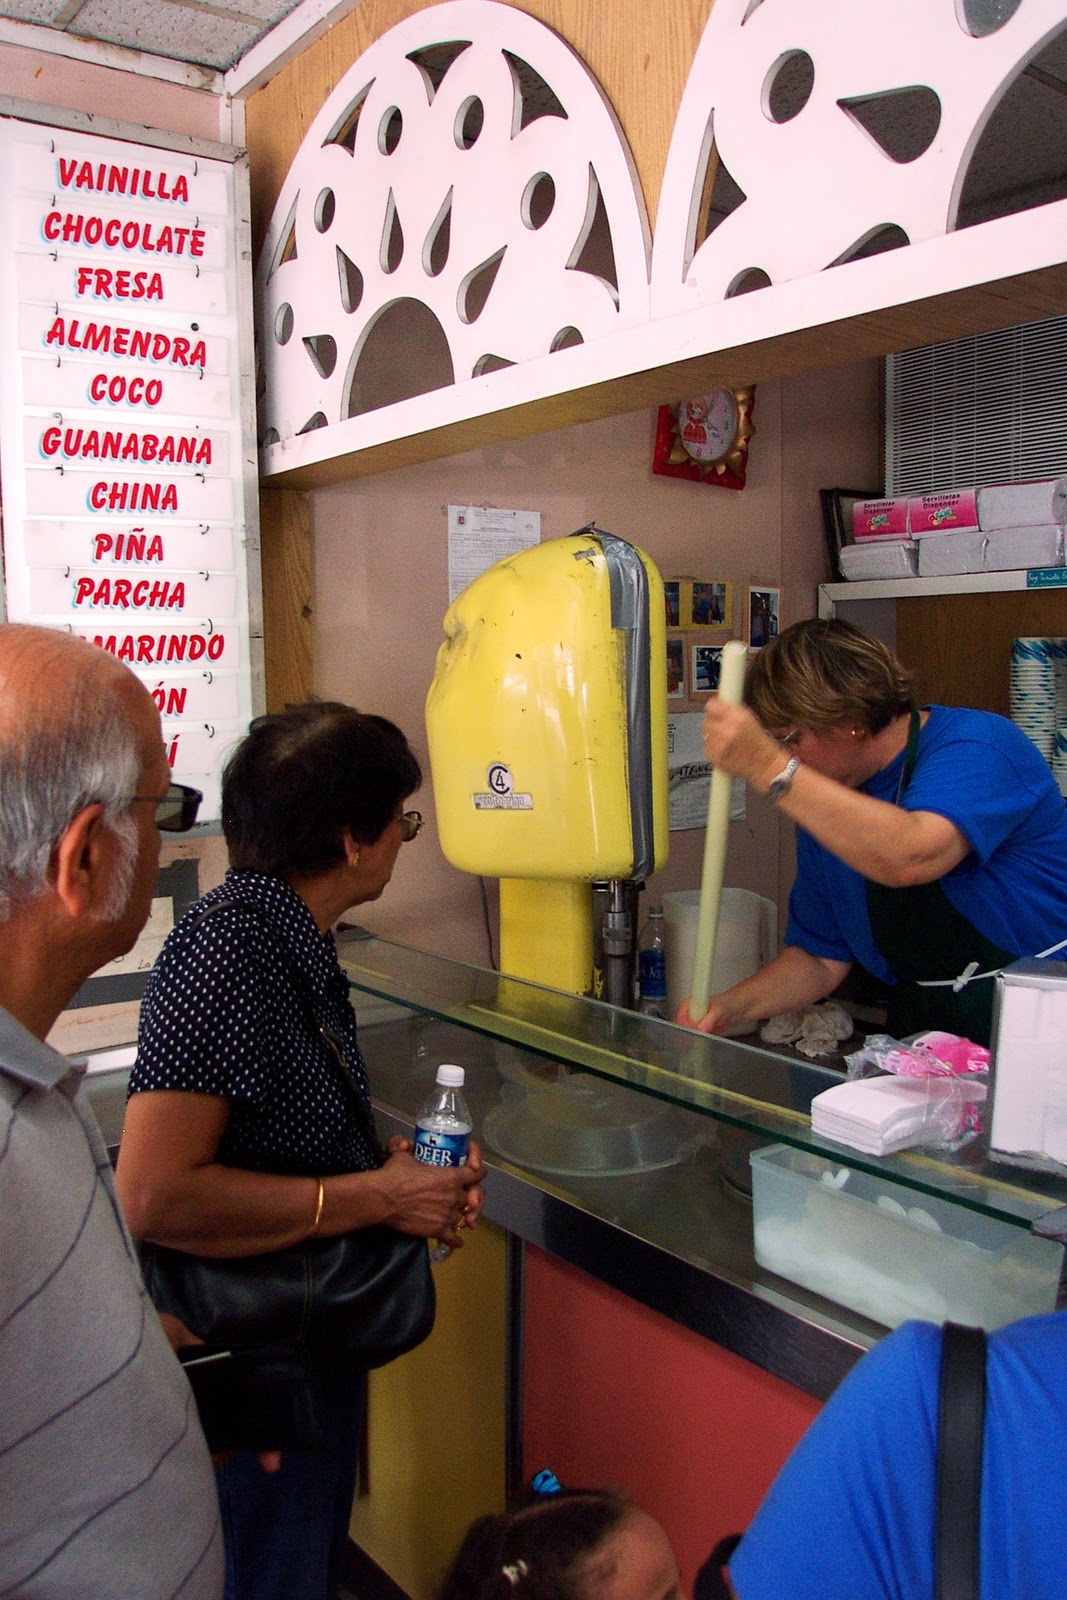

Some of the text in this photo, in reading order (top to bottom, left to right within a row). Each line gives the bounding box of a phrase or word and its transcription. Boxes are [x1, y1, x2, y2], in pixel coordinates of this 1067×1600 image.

[58, 157, 189, 203] VAINILLA
[43, 211, 206, 257] CHOCOLATE
[76, 266, 164, 301] FRESA
[45, 317, 207, 368] ALMENDRA
[89, 373, 163, 406] COCO
[41, 426, 212, 466] GUANABANA
[90, 481, 179, 512] CHINA
[94, 527, 165, 562] PIÑA
[75, 576, 186, 609] PARCHA
[79, 633, 226, 664] MARINDO
[415, 1142, 453, 1164] DEER
